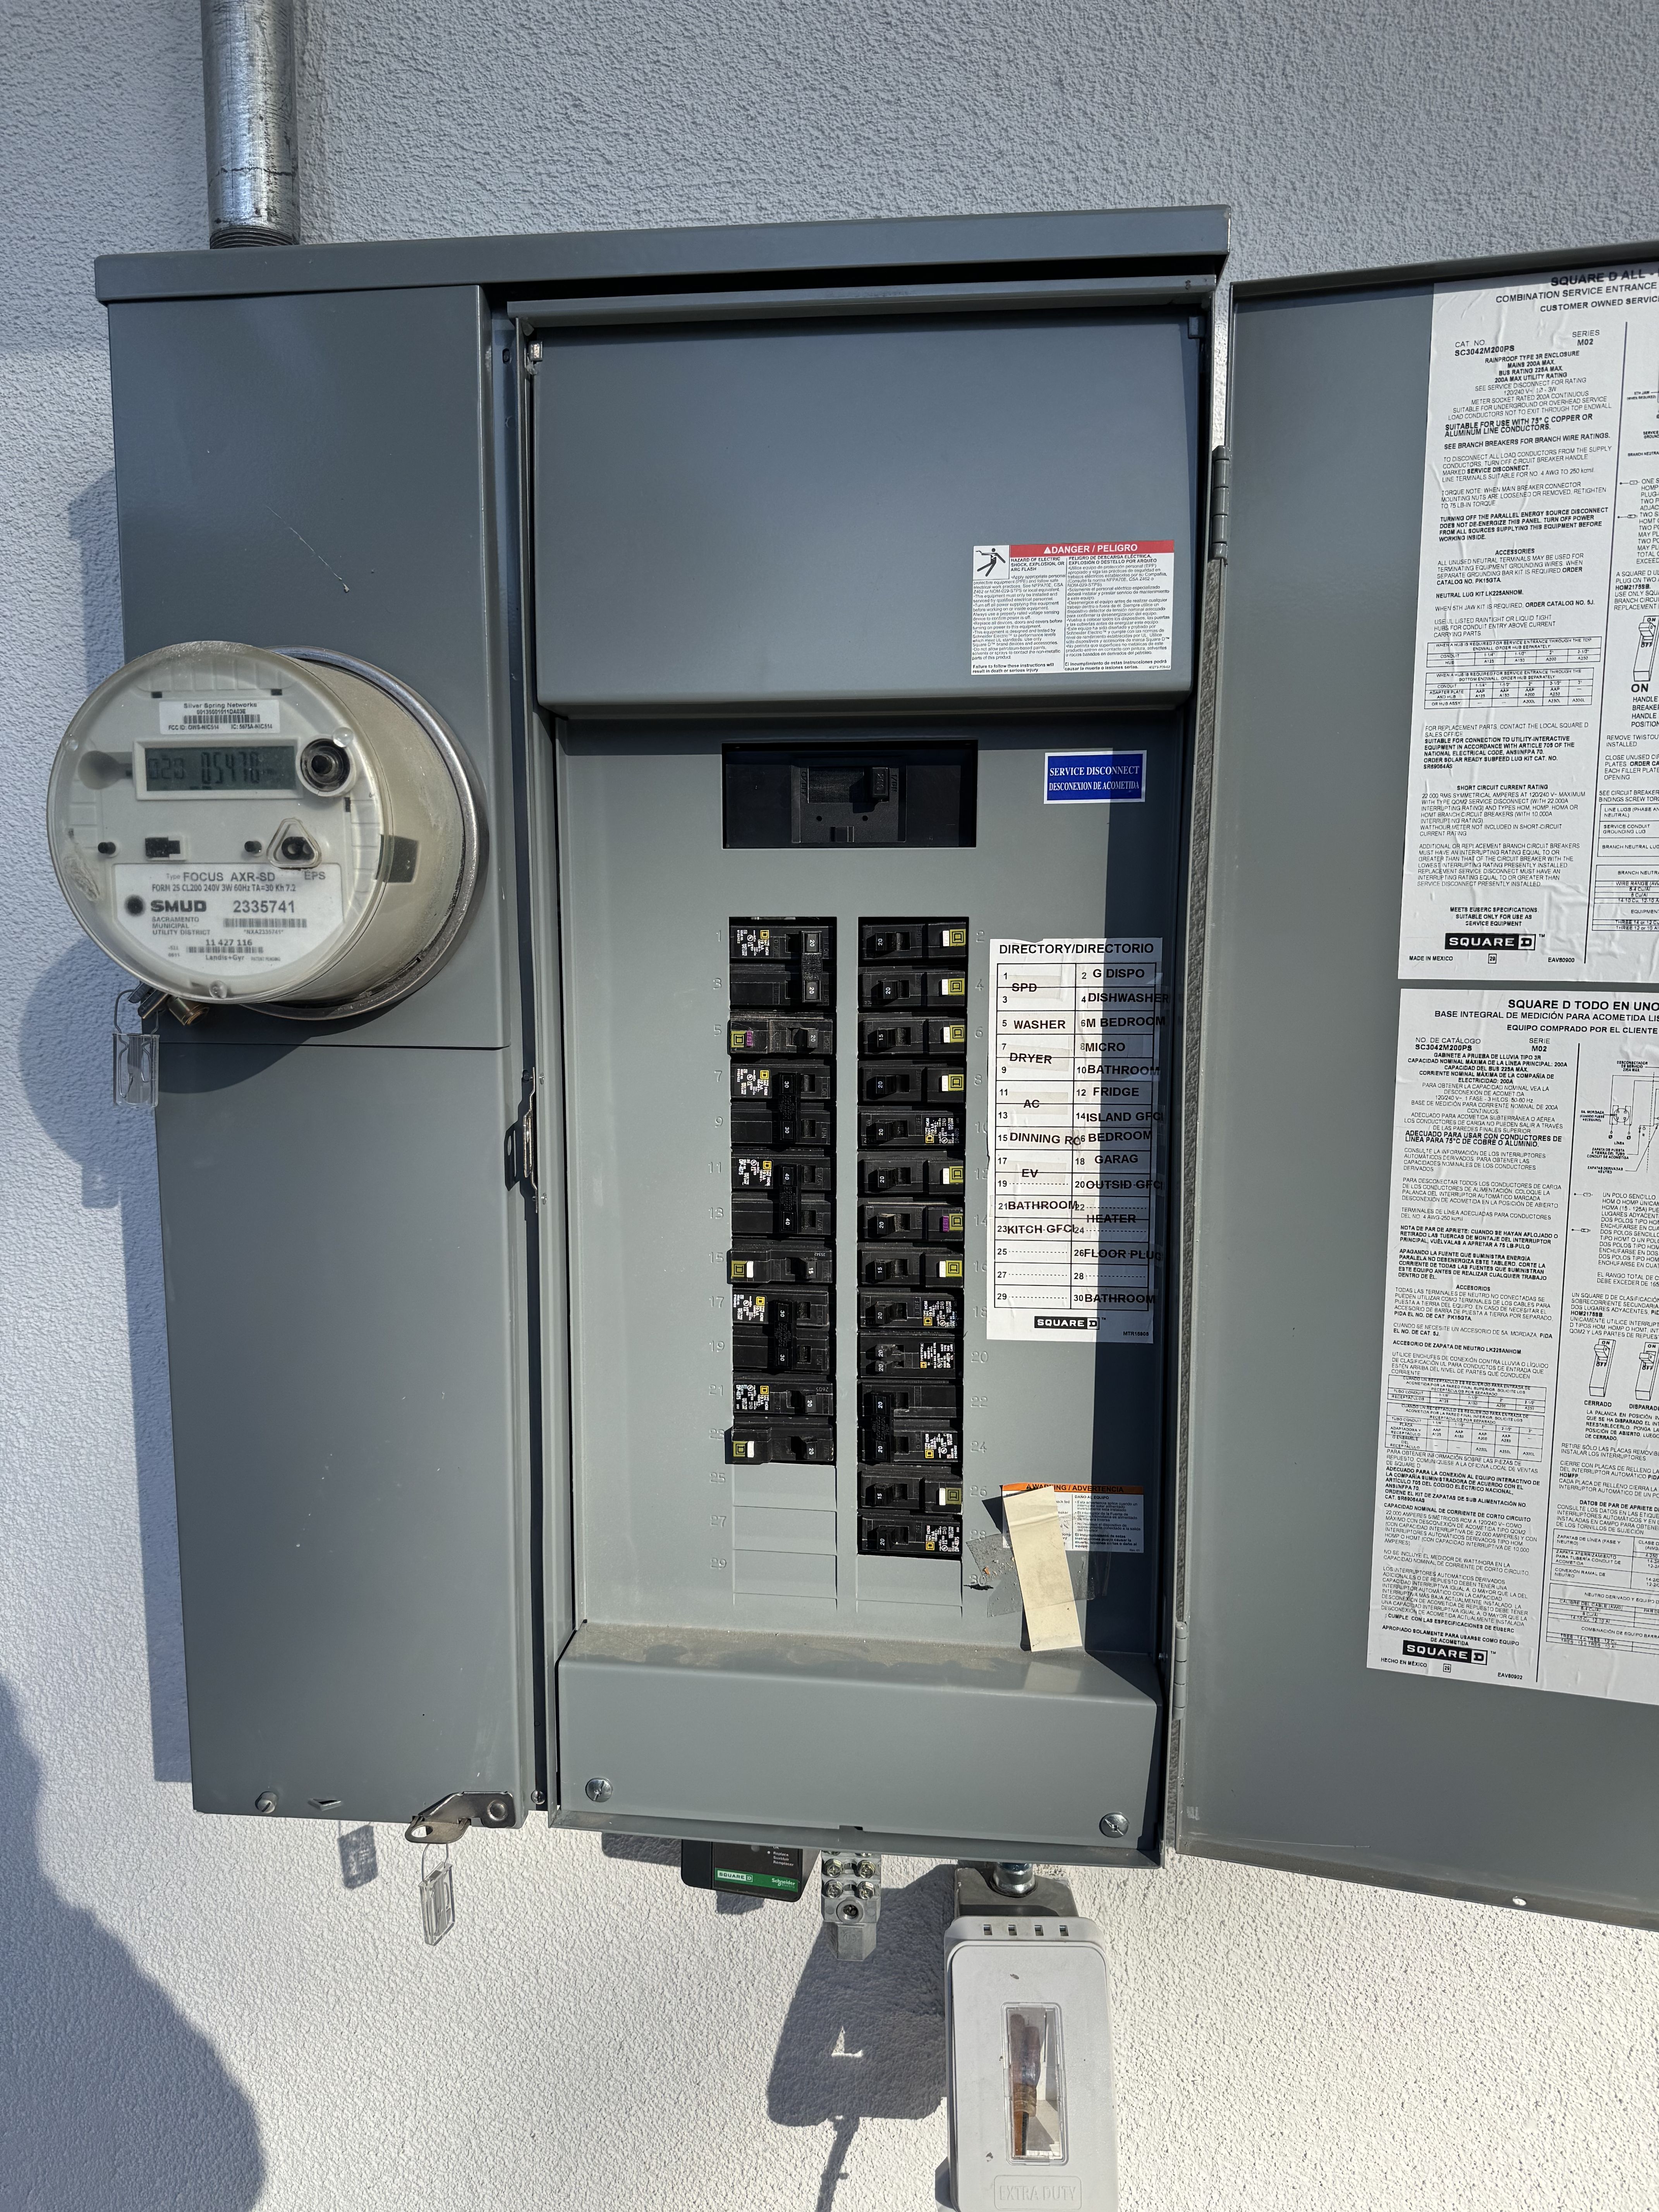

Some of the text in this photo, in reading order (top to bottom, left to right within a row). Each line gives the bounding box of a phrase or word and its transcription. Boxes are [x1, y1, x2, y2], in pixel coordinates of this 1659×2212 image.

[1551, 270, 1645, 287] SQUARE D ALL
[1496, 282, 1657, 303] COMBINATION SERVICE ENTRANCE
[1540, 302, 1588, 312] CUSTOMER
[1591, 299, 1623, 308] OWNED
[1455, 345, 1514, 356] SC3042M200PS
[1445, 429, 1481, 437] ALUMINUM
[1501, 423, 1551, 433] CONDUCTORS.
[1051, 545, 1090, 554] DANGER
[1097, 544, 1137, 552] PELIGRO
[1631, 683, 1648, 693] ON
[1050, 766, 1140, 776] SERVICE DISCONNECT
[1049, 782, 1092, 791] DESCONEXION
[1103, 781, 1139, 790] ACOMETIDA
[183, 872, 223, 881] FOCUS
[230, 872, 275, 881] AXR-SD
[304, 871, 325, 880] EPS
[150, 900, 207, 912] SMUD
[233, 900, 295, 913] 2335741
[1449, 937, 1532, 947] SQUARE D
[1000, 943, 1154, 954] DIRECTORY/DIRECTORIO
[1093, 969, 1102, 978] G
[1106, 969, 1145, 978] DISPO
[1012, 983, 1037, 992] SPD
[1088, 993, 1168, 1003] DISHWASHER
[1508, 1000, 1659, 1011] SQUARE D TODO EN UNO
[1520, 1011, 1563, 1020] MEDICIÓN
[1014, 1020, 1066, 1029] WASHER
[1087, 1018, 1096, 1027] M
[1101, 1016, 1166, 1027] BEDROOM
[714, 1024, 721, 1036] 5
[1085, 1042, 1125, 1052] MICRO
[1010, 1053, 1052, 1063] DRYER
[1087, 1065, 1160, 1075] BATHROOM
[714, 1070, 723, 1082] 7
[1093, 1087, 1139, 1097] FRIDGE
[1023, 1099, 1040, 1108] AC
[715, 1116, 723, 1128] 9
[1087, 1112, 1131, 1122] ISLAND
[1136, 1112, 1163, 1121] GFCI
[1010, 1133, 1060, 1144] DINNING
[1088, 1130, 1152, 1142] BEDROOM
[1095, 1154, 1138, 1164] GARAG
[1022, 1169, 1038, 1178] EV
[1086, 1180, 1132, 1190] OUTSID
[1135, 1180, 1163, 1190] GFCI
[1008, 1200, 1077, 1210] BATHROOM
[1087, 1214, 1136, 1223] HEATER
[1008, 1224, 1042, 1234] KITCH
[1046, 1224, 1075, 1233] GFCI
[1084, 1248, 1126, 1258] FLOOR
[1130, 1249, 1161, 1261] PLUG
[709, 1296, 725, 1307] 17
[1085, 1293, 1156, 1304] BATHROOM
[1037, 1318, 1085, 1327] SQUARE
[1407, 1644, 1468, 1660] SQUARE
[771, 1878, 795, 1886] Schneider
[1000, 2186, 1076, 2200] EXTRA DUTY
